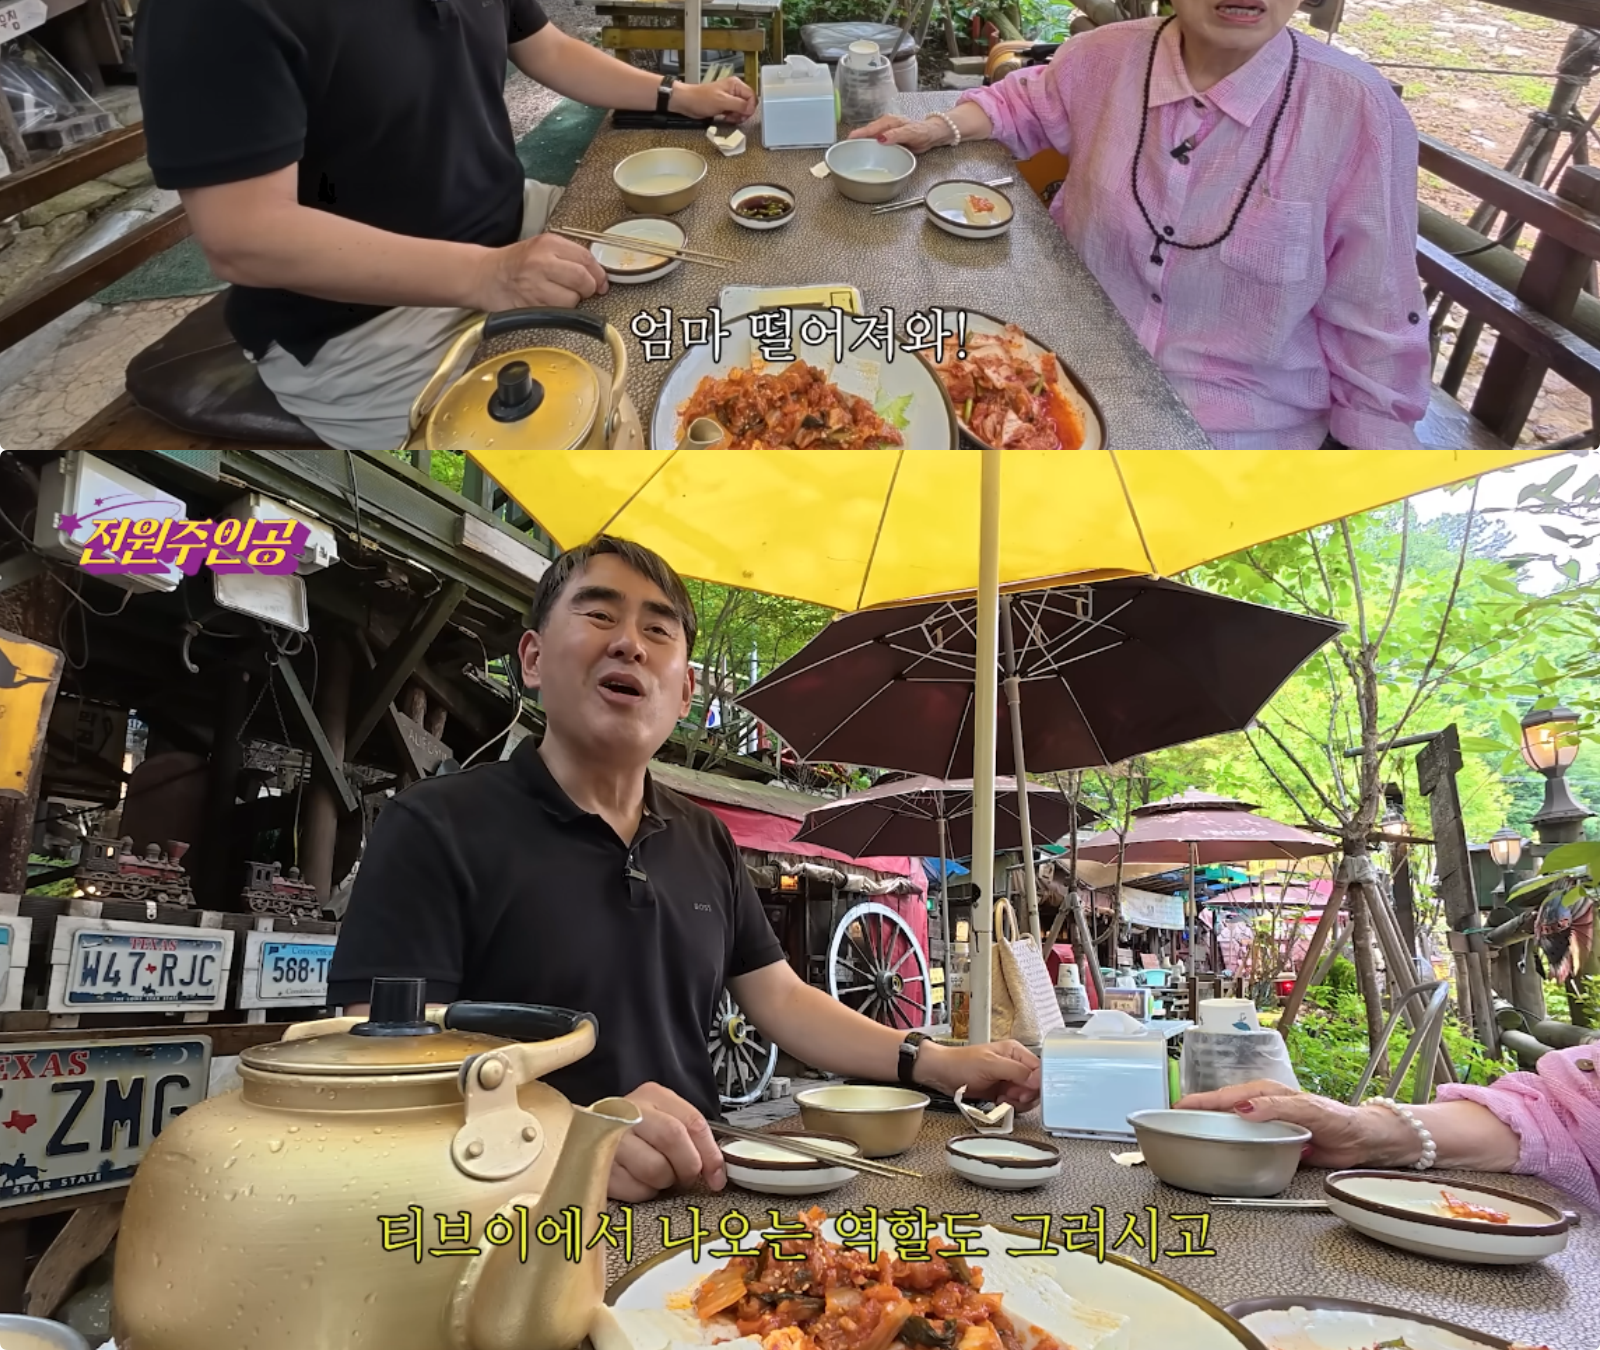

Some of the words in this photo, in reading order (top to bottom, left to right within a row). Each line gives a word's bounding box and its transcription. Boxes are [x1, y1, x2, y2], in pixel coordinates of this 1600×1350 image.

[130, 937, 178, 951] TEXAS
[80, 950, 146, 987] W47
[158, 953, 216, 987] RJC
[46, 1074, 190, 1156] ZMG
[13, 1182, 51, 1195] STAR
[61, 1173, 102, 1187] STATE
